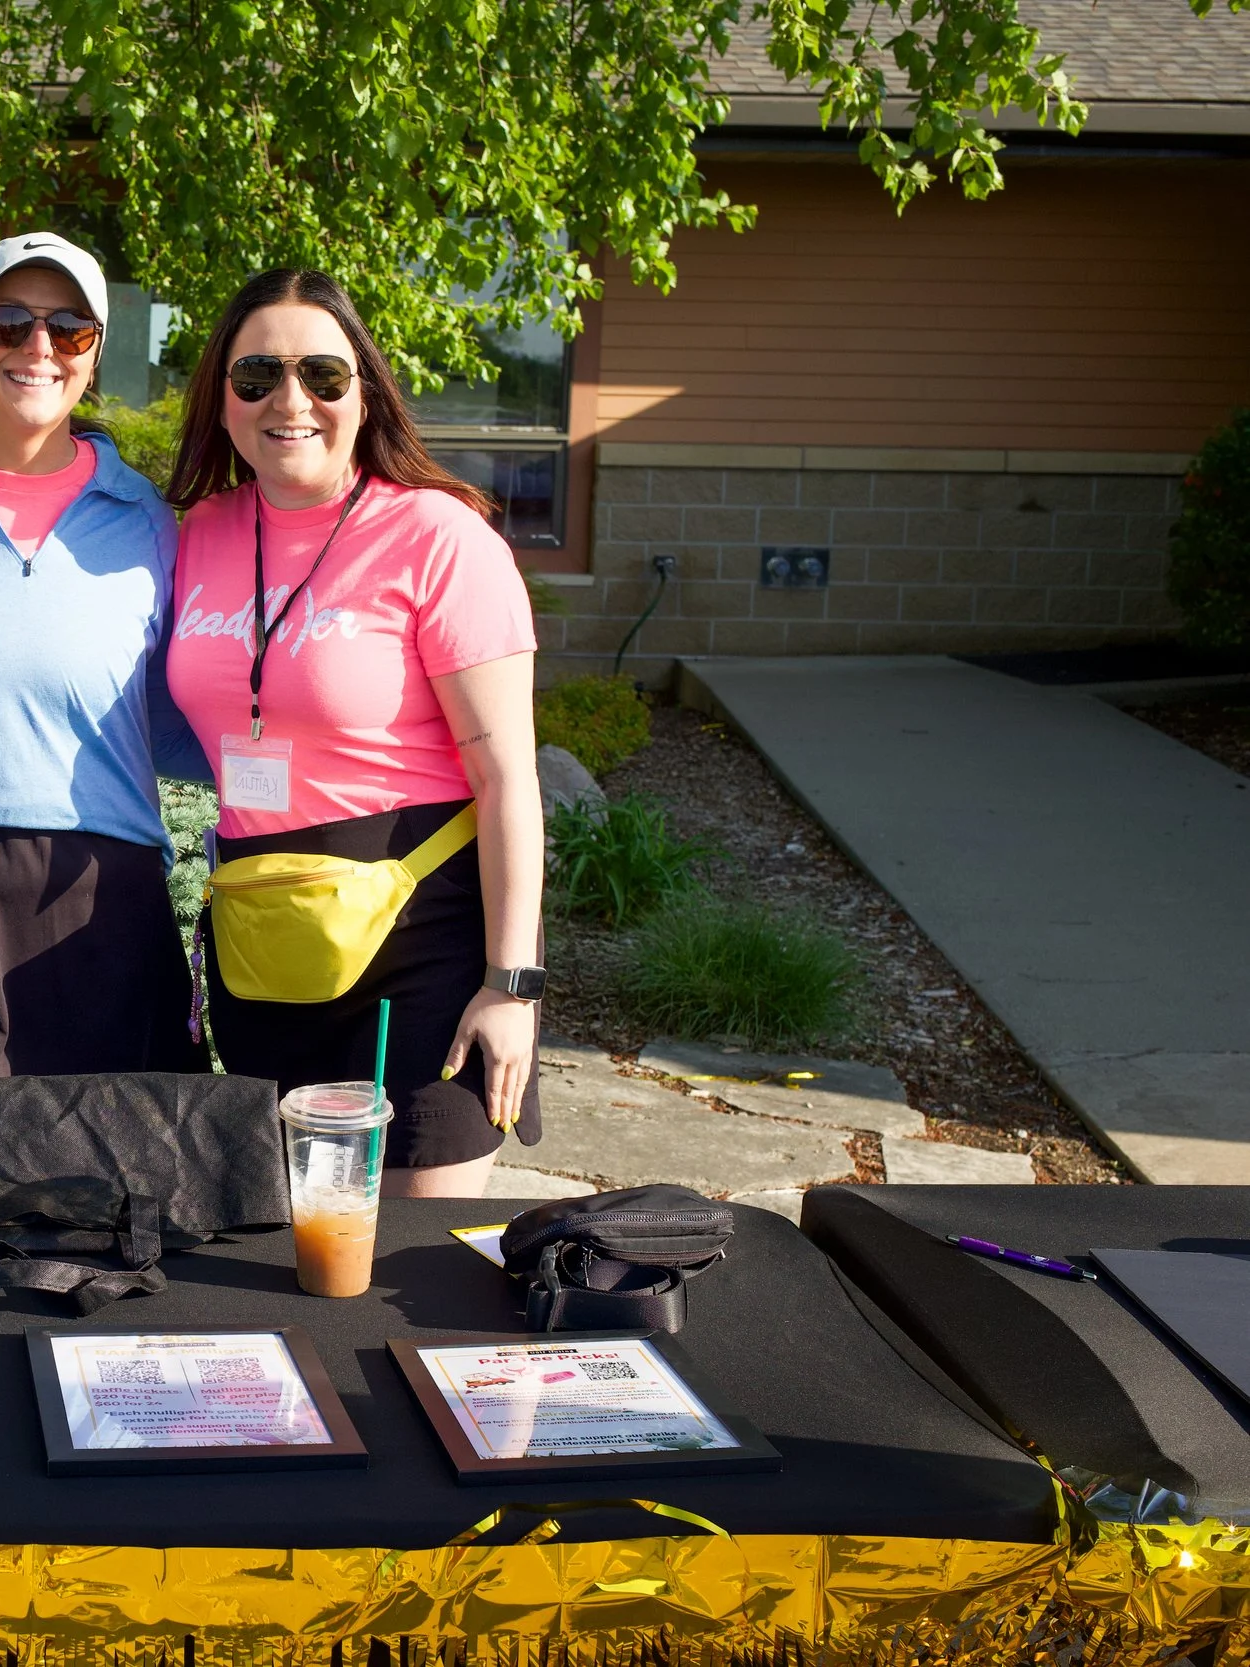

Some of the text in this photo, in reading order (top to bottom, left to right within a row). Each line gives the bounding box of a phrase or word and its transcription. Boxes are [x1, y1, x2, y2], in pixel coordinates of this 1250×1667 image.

[558, 1352, 619, 1361] Packs!
[201, 1386, 269, 1394] Mulligans:
[563, 1438, 626, 1446] Mentorship
